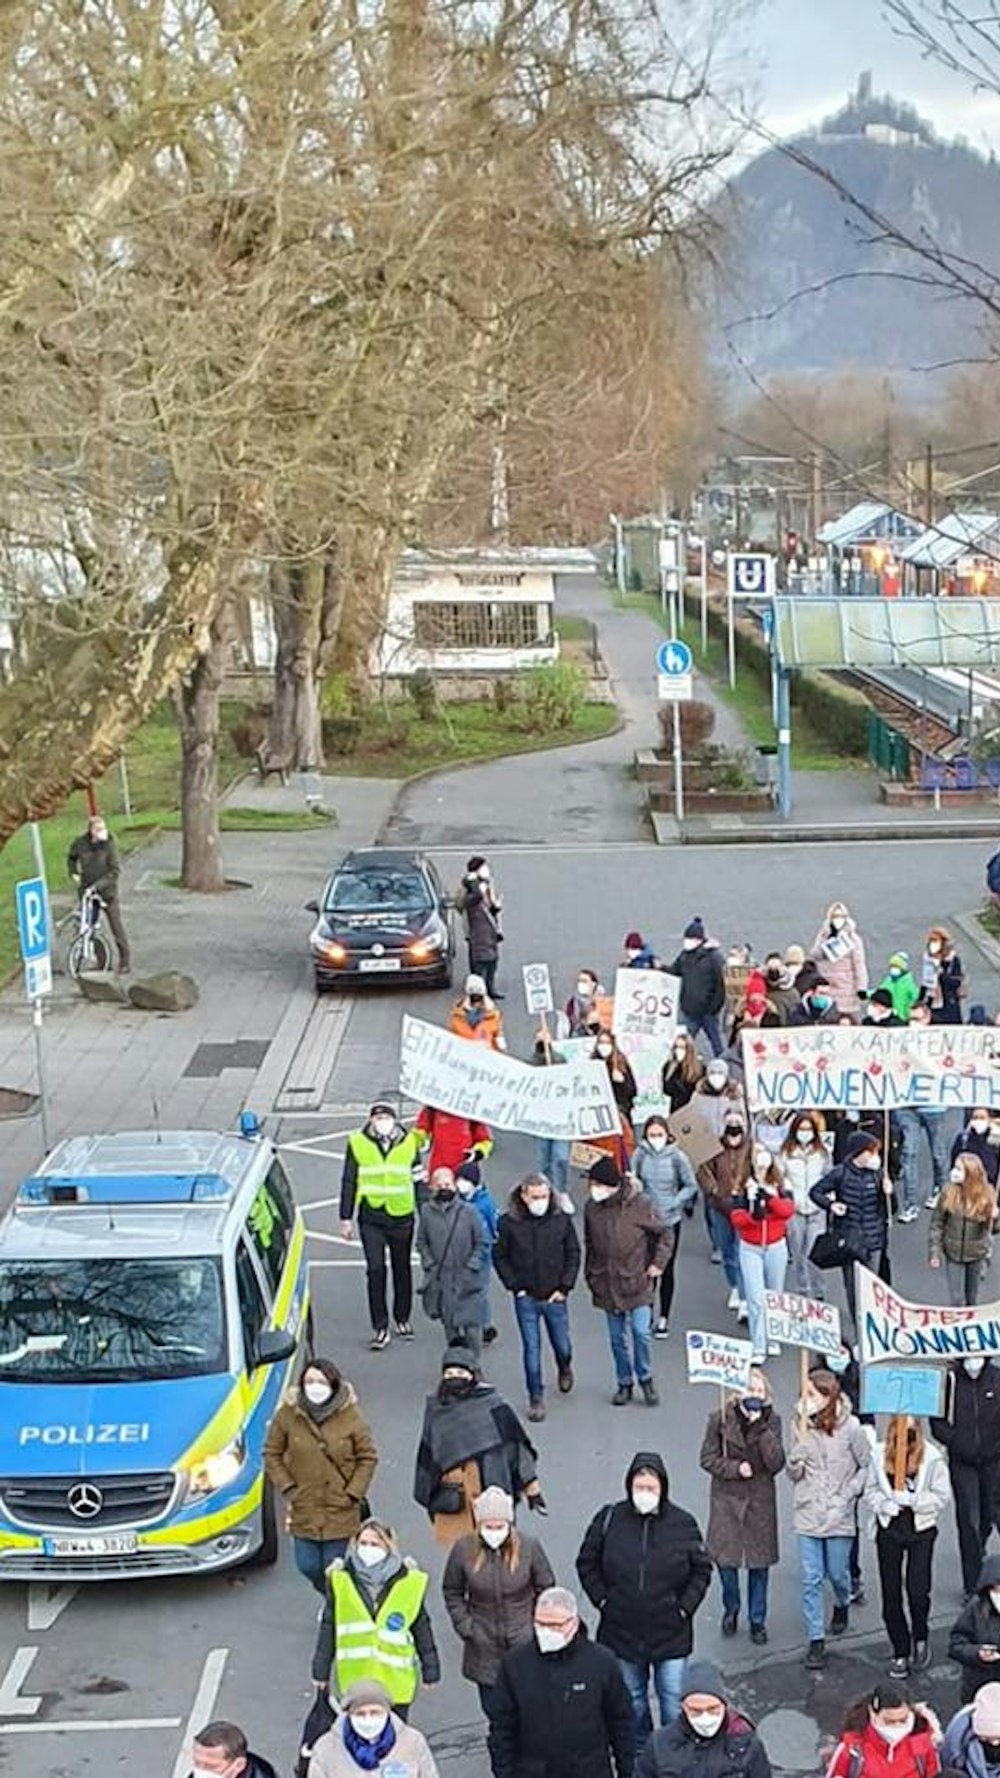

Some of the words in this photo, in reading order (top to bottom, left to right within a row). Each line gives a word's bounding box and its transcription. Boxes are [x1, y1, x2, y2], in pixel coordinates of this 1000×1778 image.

[738, 560, 764, 590] U
[631, 990, 673, 1018] SOS
[767, 1292, 833, 1323] BILDUNG
[20, 1423, 149, 1445] POLIZEI
